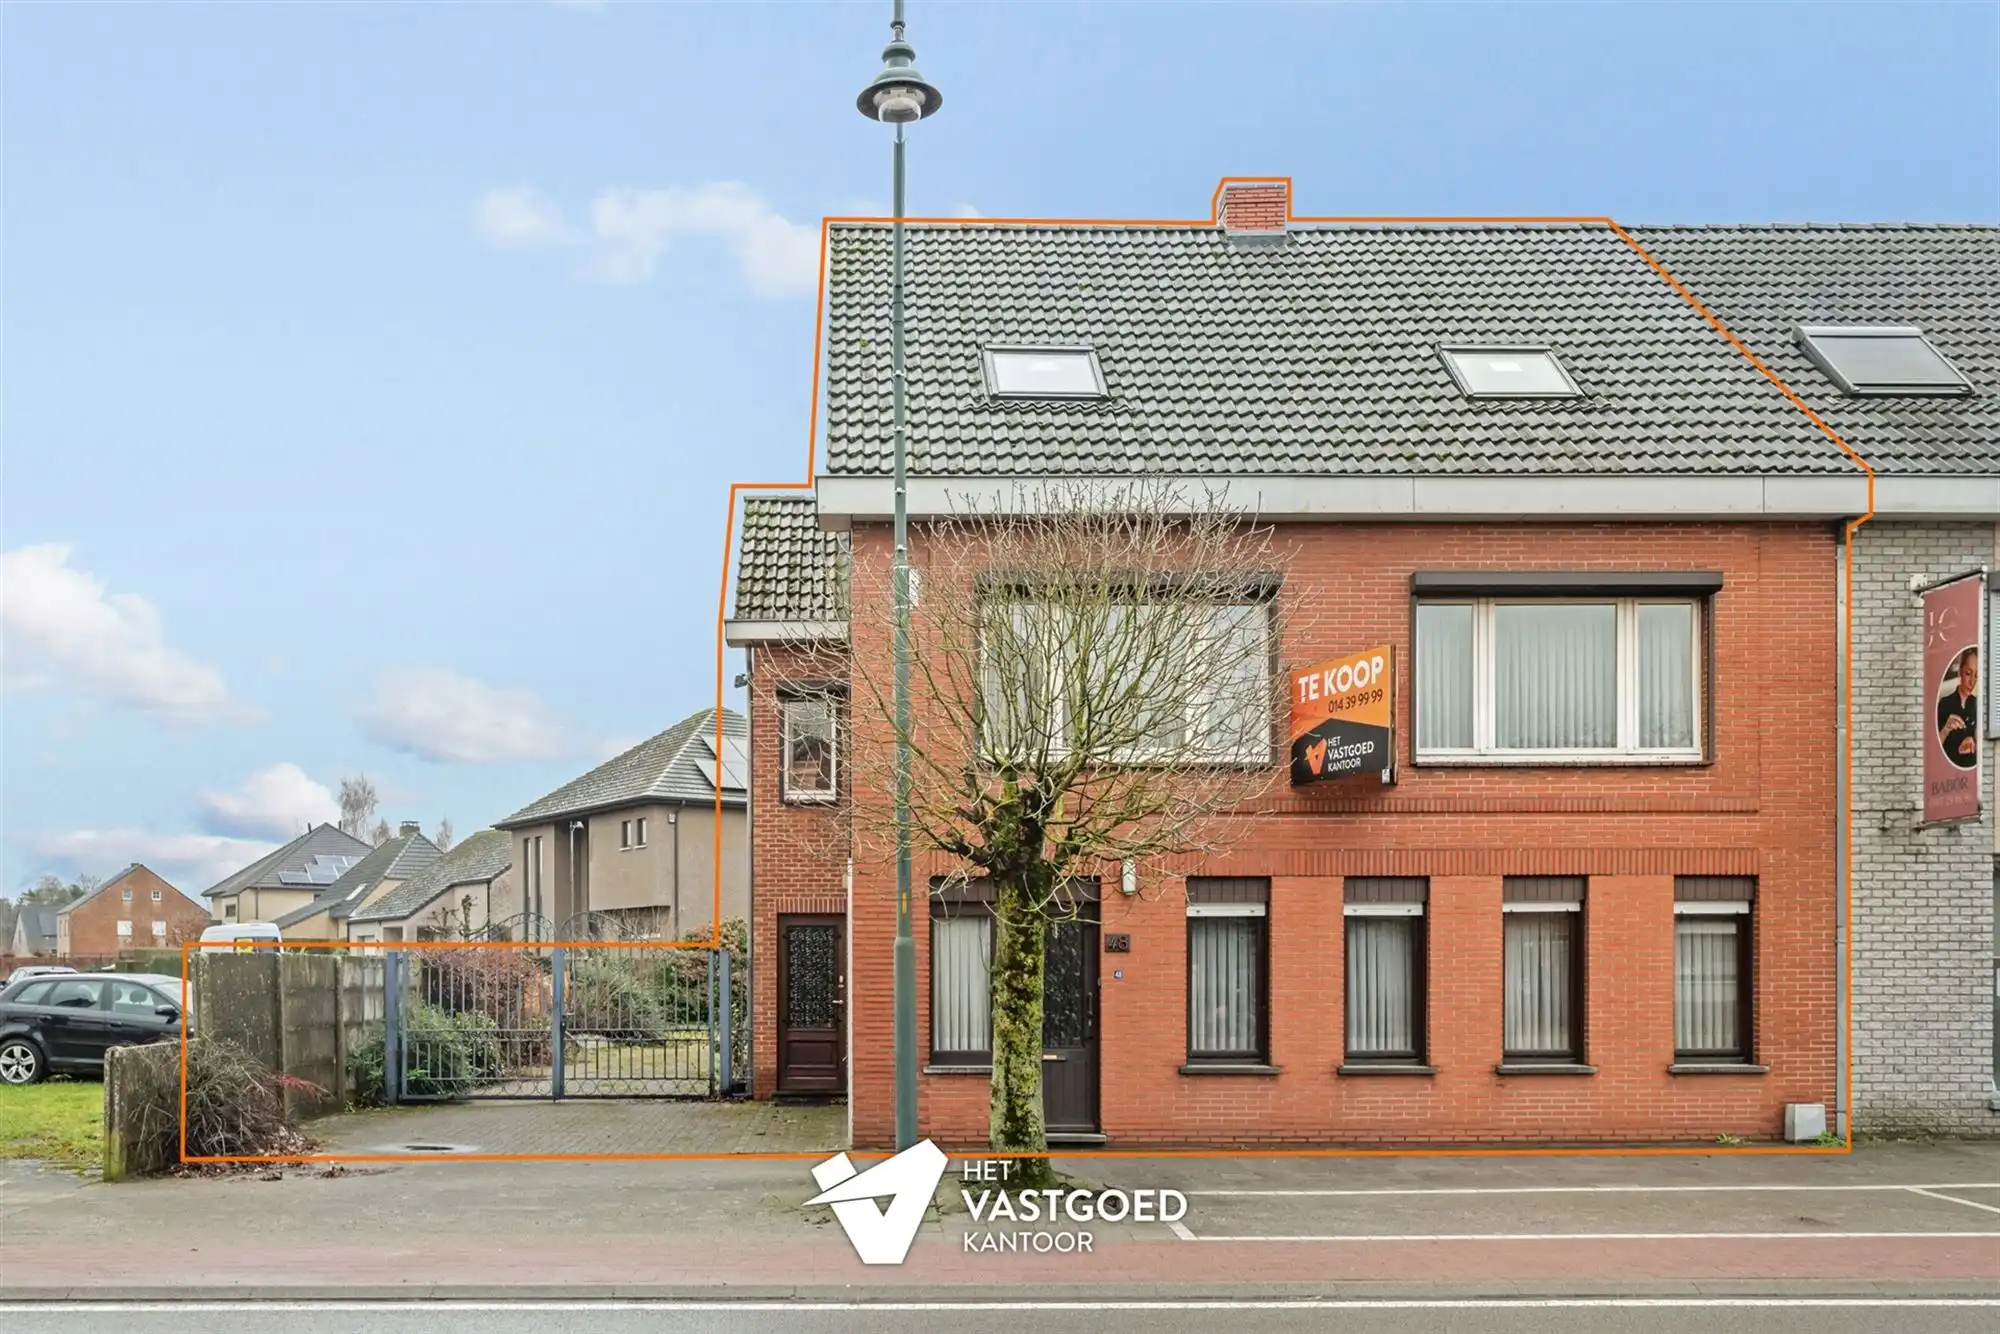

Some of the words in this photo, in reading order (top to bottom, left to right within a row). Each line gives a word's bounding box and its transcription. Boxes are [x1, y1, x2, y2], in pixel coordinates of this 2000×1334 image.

[1298, 672, 1320, 703] TE
[1324, 655, 1384, 696] KOOP
[1328, 700, 1344, 713] 014
[1345, 695, 1357, 710] 39
[1358, 691, 1370, 706] 99
[1371, 688, 1384, 703] 99
[1328, 736, 1341, 746] HET
[1328, 741, 1374, 760] VASTGOED
[1328, 757, 1361, 772] KANTOOR
